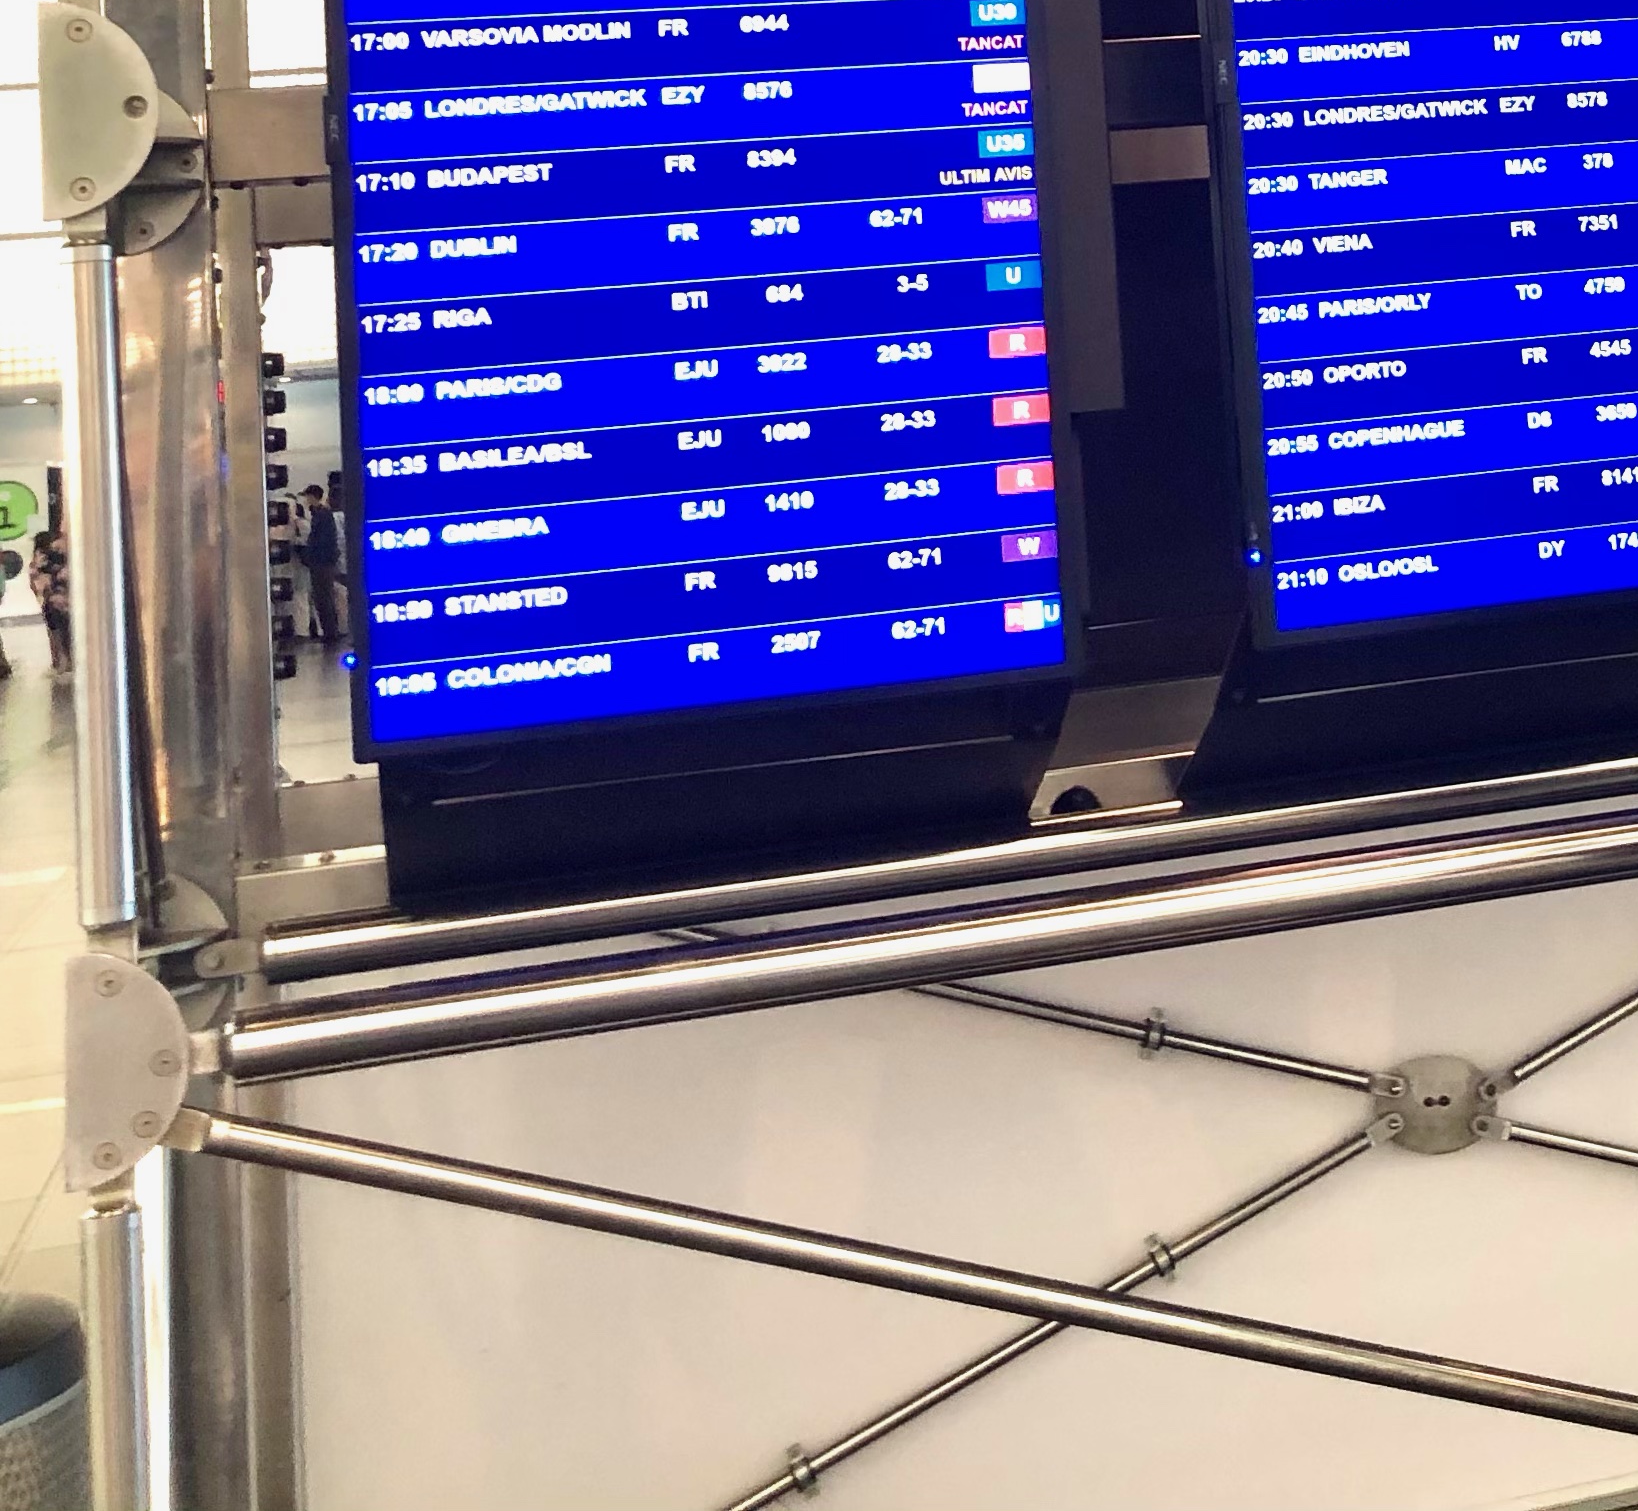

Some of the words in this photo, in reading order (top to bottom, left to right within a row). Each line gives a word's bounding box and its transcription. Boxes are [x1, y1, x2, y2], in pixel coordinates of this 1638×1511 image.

[420, 20, 540, 49] VARSOVIA
[542, 20, 632, 43] MODLIN
[657, 18, 690, 38] FR
[957, 34, 1025, 51] TANCAT
[1238, 47, 1289, 67] 20:30
[1298, 40, 1411, 63] EINDHOVEN
[1493, 34, 1521, 52] HV
[424, 88, 648, 119] LONDRES/GATWICK
[660, 85, 706, 106] EZY
[961, 99, 1029, 118] TANCAT
[1242, 111, 1294, 131] 20:30
[1303, 98, 1489, 127] LONDRES/GATWICK
[1499, 95, 1536, 113] EZY
[355, 171, 416, 193] 17:10
[427, 162, 554, 189] BUDAPEST
[993, 165, 1033, 182] AVIS
[1247, 175, 1299, 195] 20:30
[1307, 168, 1389, 191] TANGER
[429, 234, 518, 259] DUBLIN
[1252, 238, 1304, 259] 20:40
[1312, 233, 1374, 254] VIENA
[1577, 213, 1618, 233] 7351
[360, 311, 422, 334] 17:25
[432, 306, 493, 329] RIGA
[671, 290, 709, 311] BTI
[896, 273, 929, 293] 3-5
[1257, 303, 1309, 325] 20:45
[1318, 292, 1432, 319] PARIS/ORLY
[1262, 368, 1314, 390] 20:50
[1322, 360, 1407, 384] OPORTO
[1589, 338, 1632, 358] 4545
[1266, 434, 1319, 456] 20:55
[1327, 419, 1466, 450] COPENHAGUE
[1272, 500, 1324, 523] 21:00
[1333, 494, 1386, 516] IBIZA
[1276, 567, 1329, 591] 21:10
[1337, 554, 1440, 583] OSLO/OSL
[1538, 539, 1566, 559] DY
